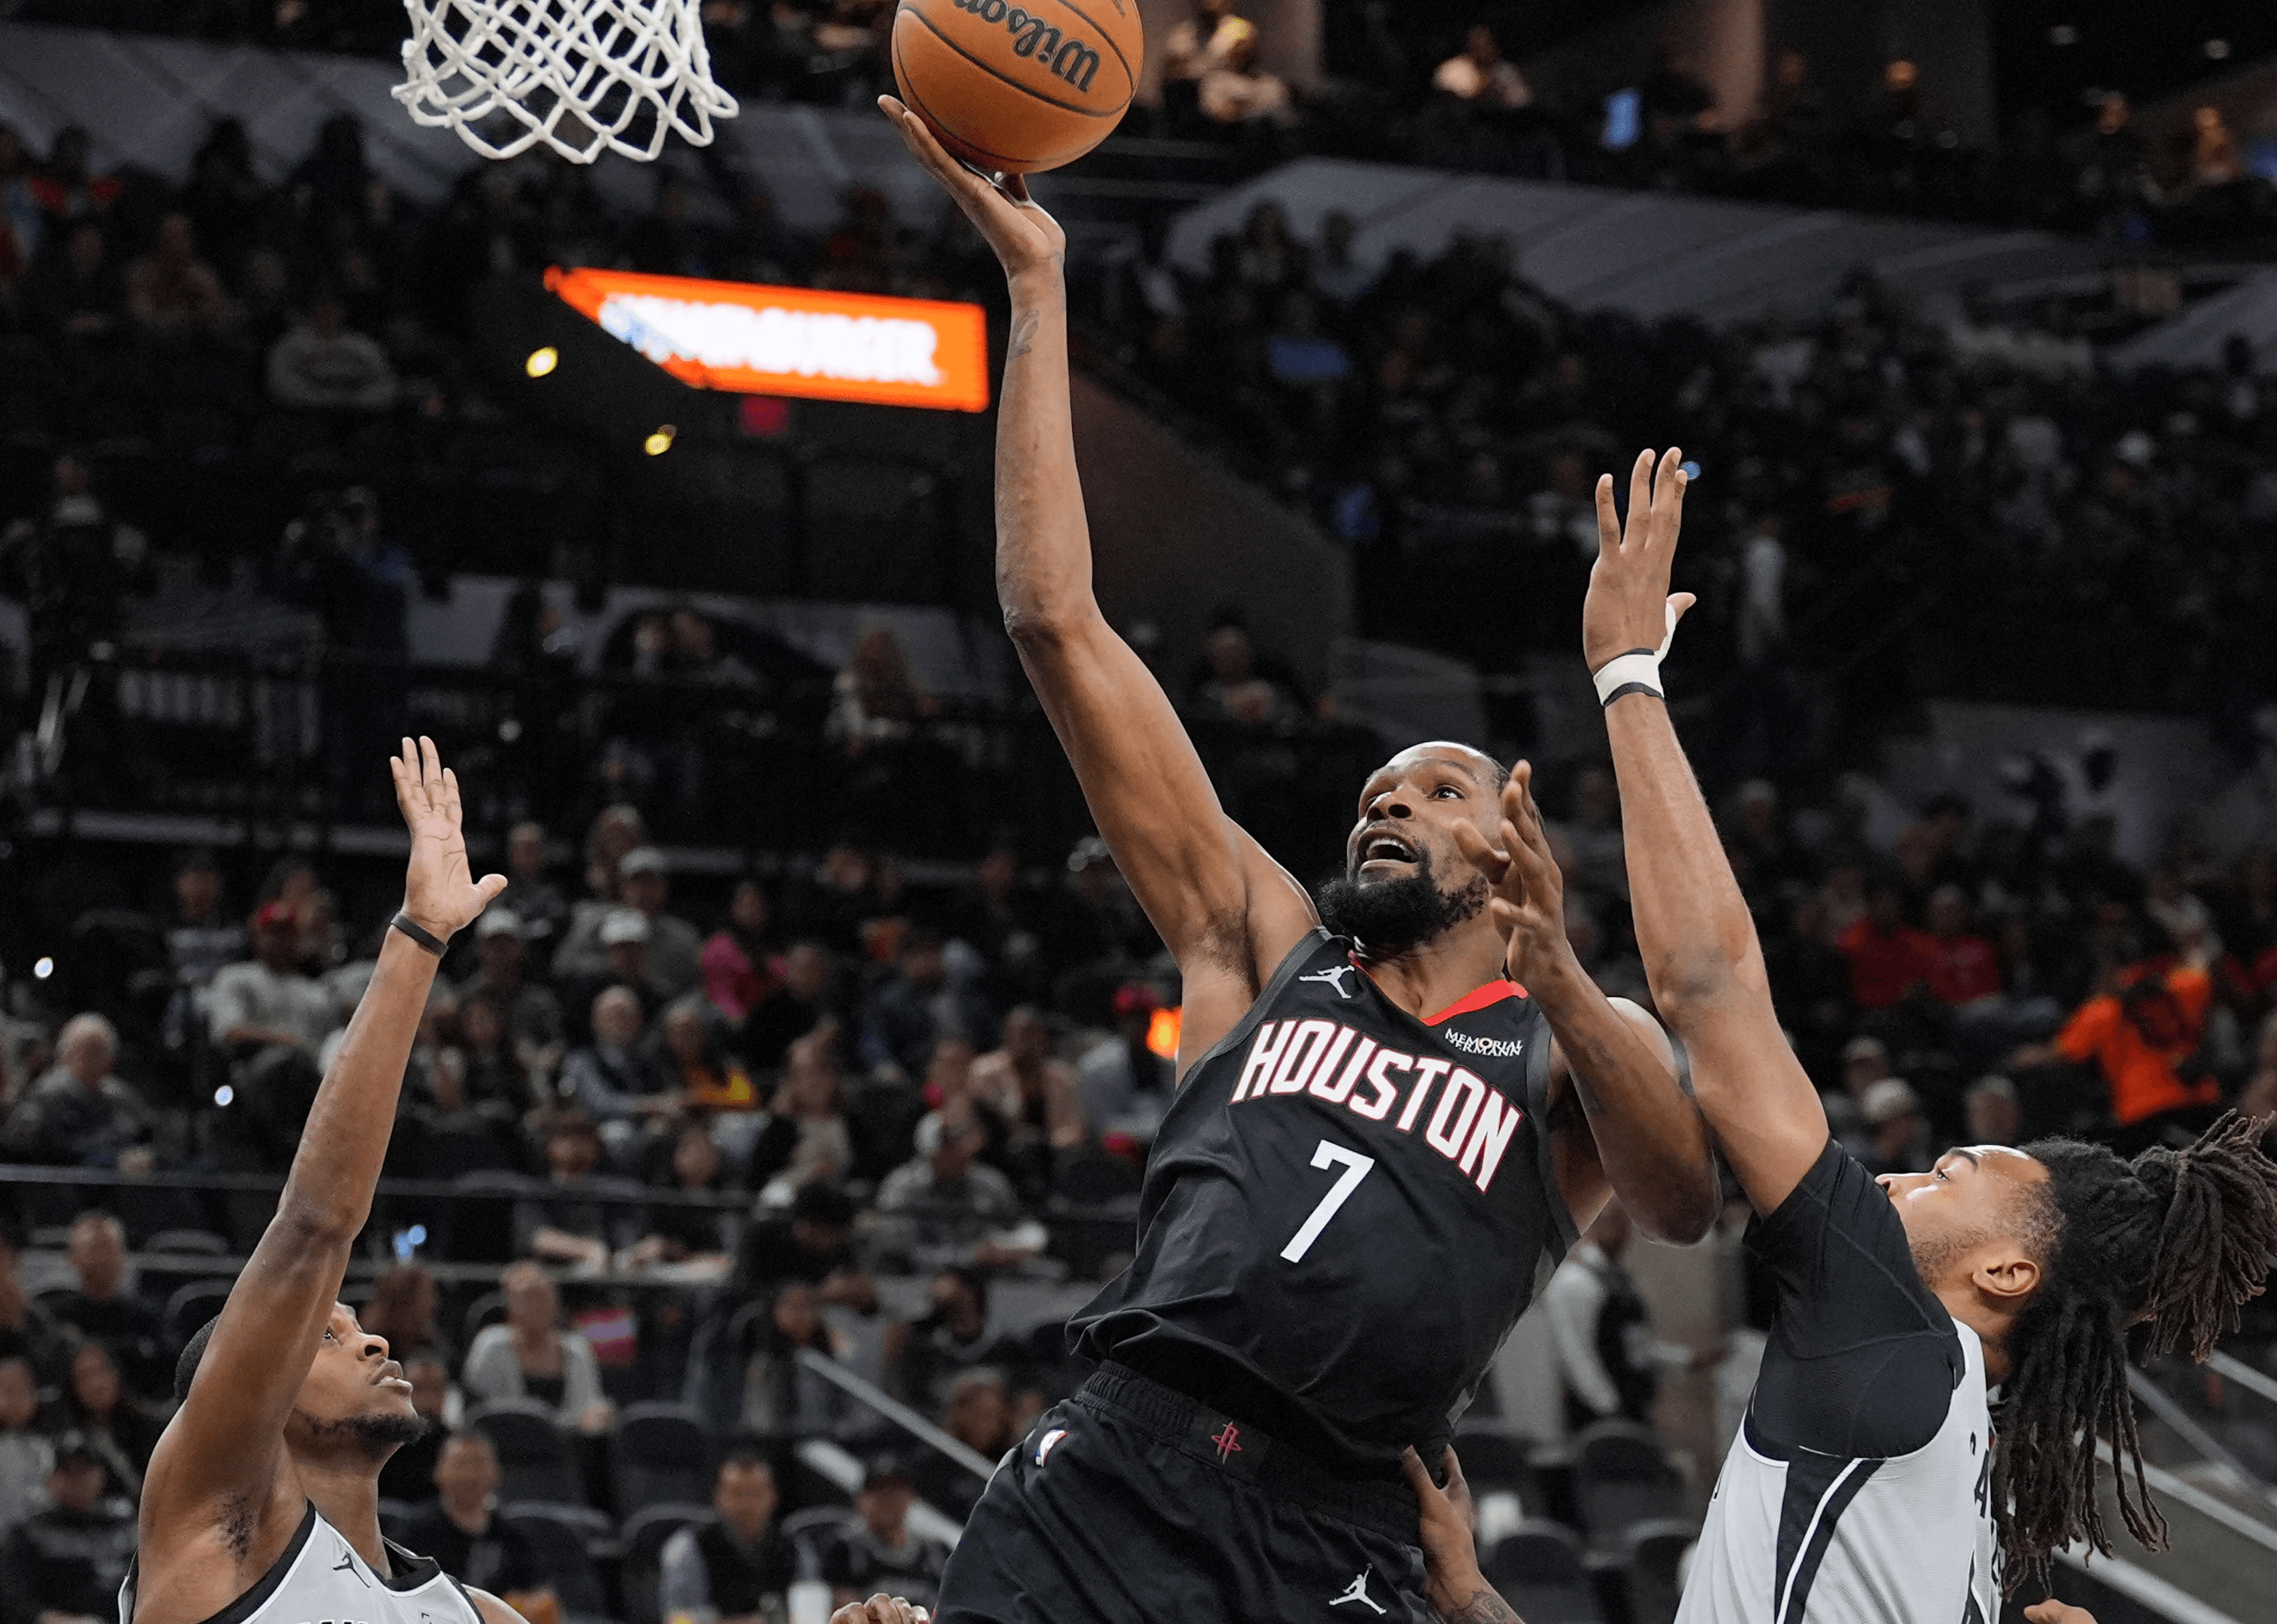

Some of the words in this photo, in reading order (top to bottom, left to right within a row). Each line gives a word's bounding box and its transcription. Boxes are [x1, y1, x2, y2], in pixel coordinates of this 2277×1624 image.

[1445, 1027, 1523, 1050] MEMORIAL
[1230, 1018, 1523, 1194] HOUSTON
[1280, 1139, 1375, 1263] 7
